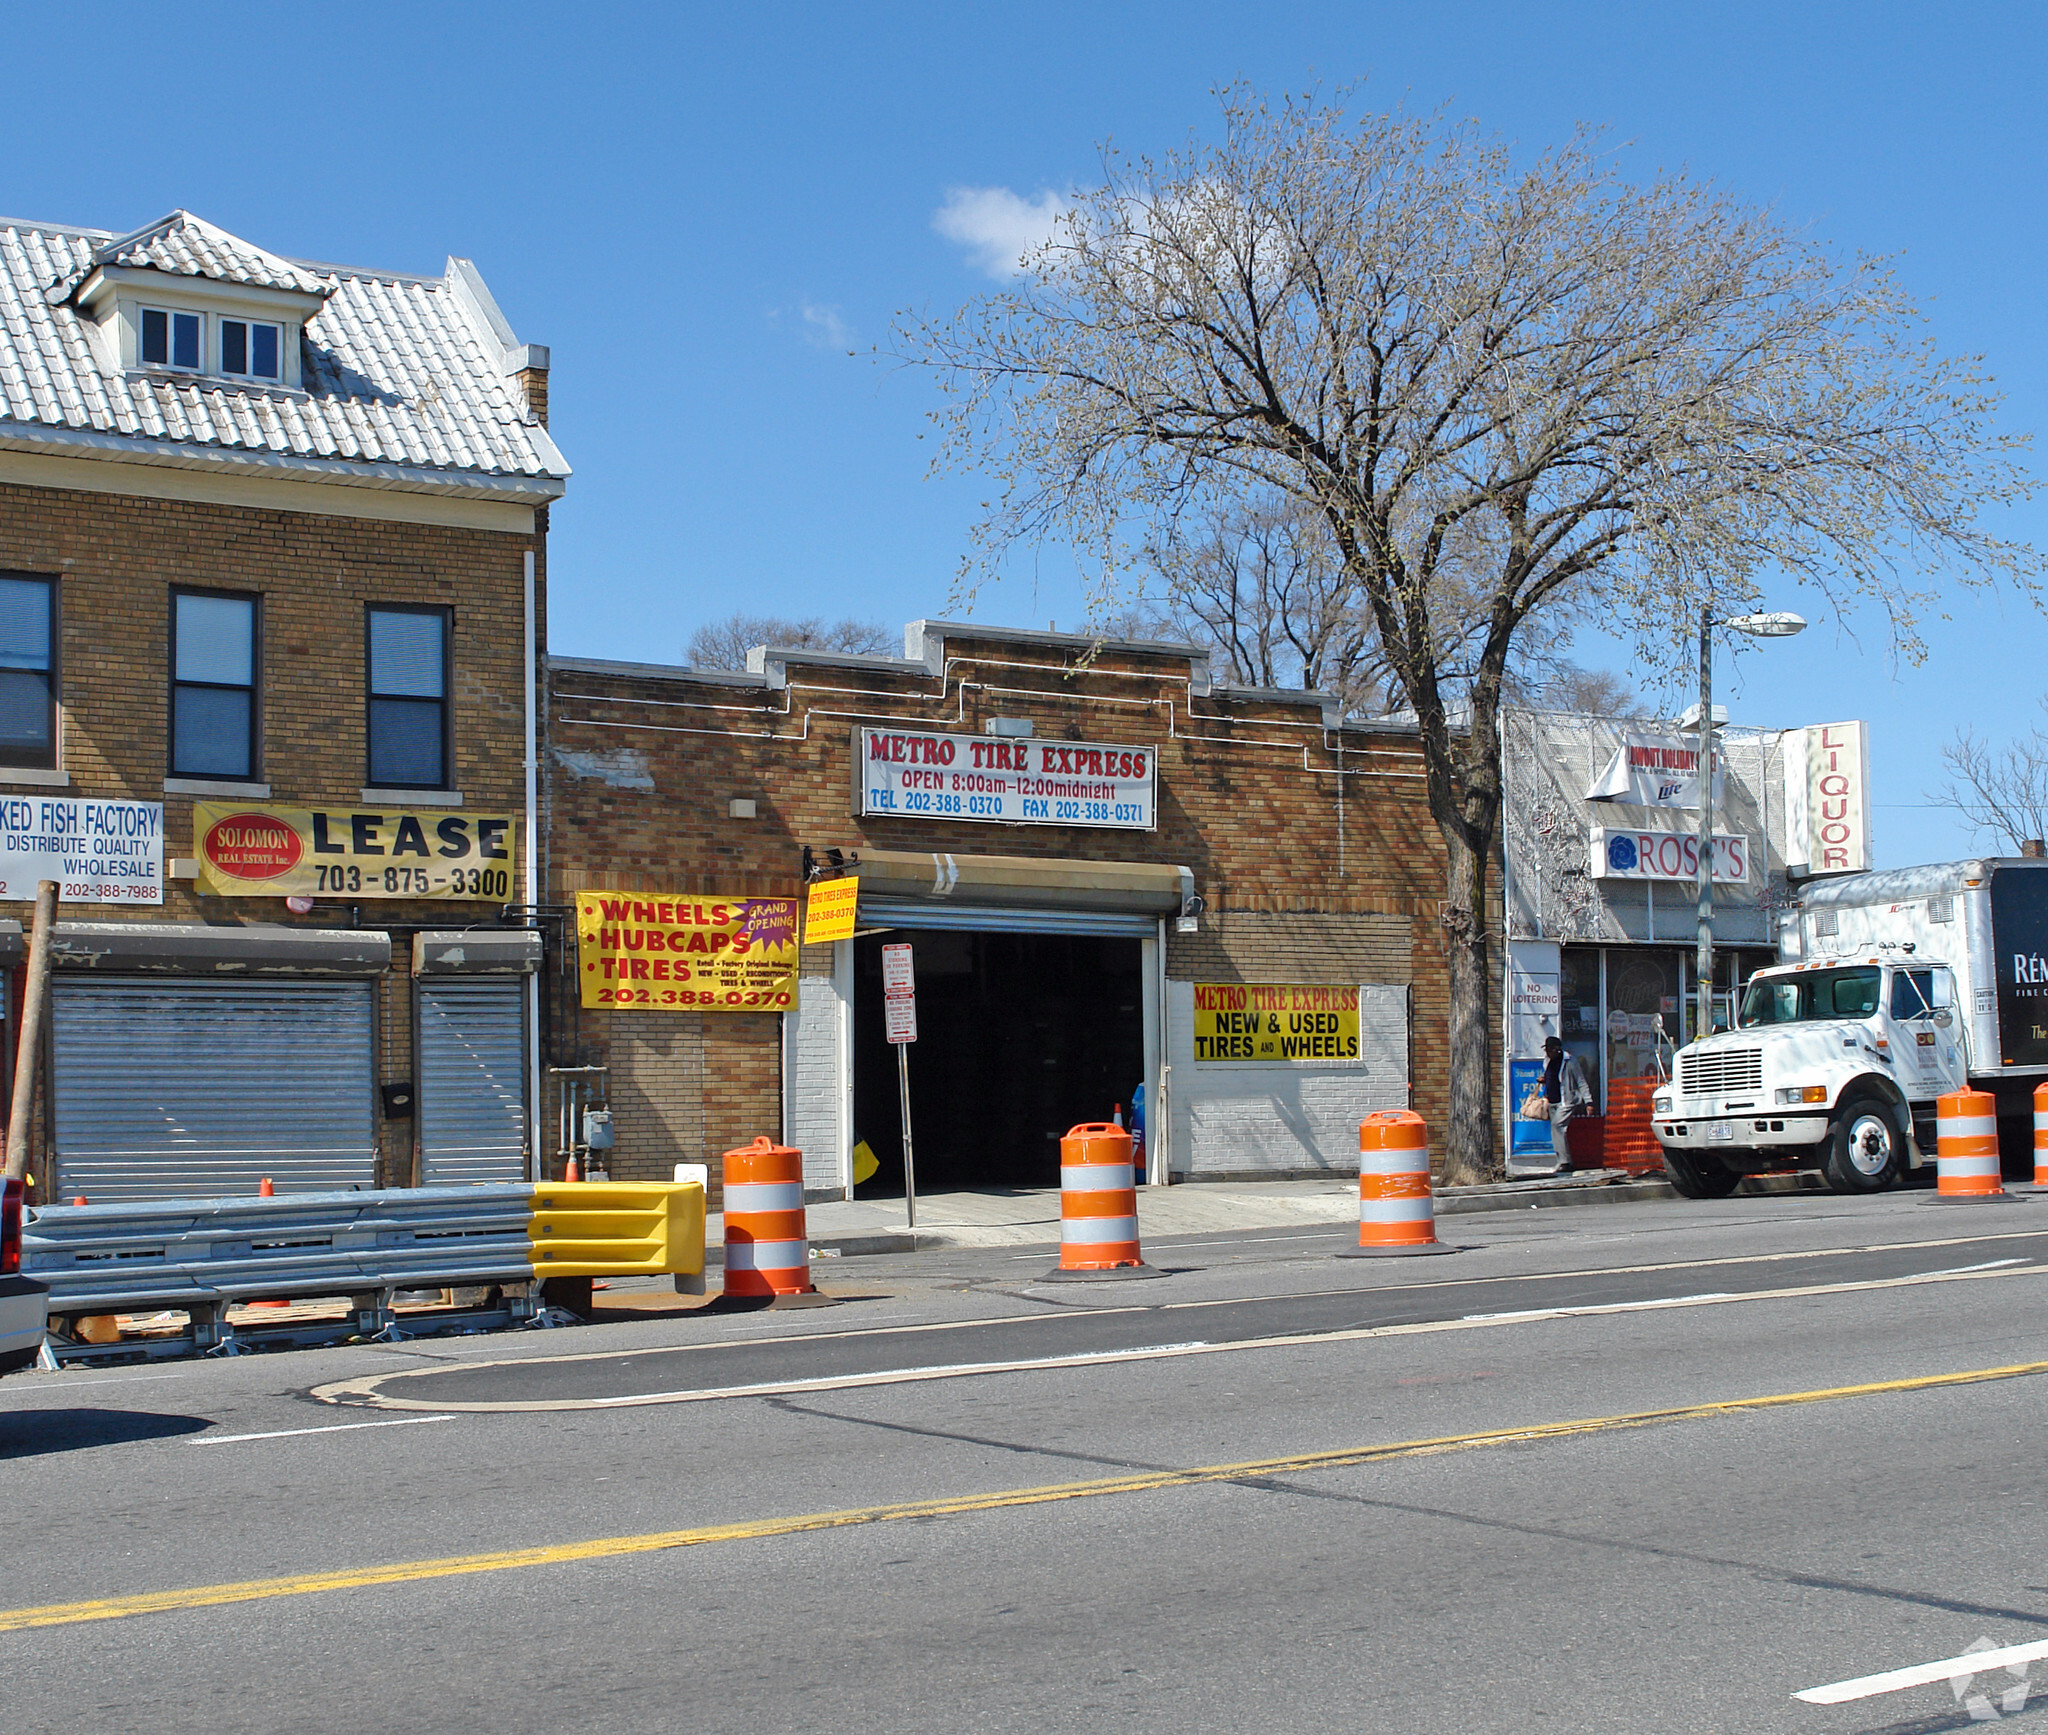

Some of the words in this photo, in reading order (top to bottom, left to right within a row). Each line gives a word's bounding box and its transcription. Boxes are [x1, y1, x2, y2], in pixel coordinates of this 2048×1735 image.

[870, 733, 956, 766] METRO
[970, 741, 1028, 771] TIRE
[1041, 746, 1146, 779] EXPRESS
[901, 769, 943, 790] OPEN
[870, 788, 898, 808] TEL
[905, 791, 1003, 815] 202-388-0370
[1657, 784, 1682, 800] Lite
[1820, 728, 1850, 868] LIQUOR
[41, 802, 77, 834] FISH
[85, 805, 157, 837] FACTORY
[1023, 799, 1049, 818] FAX
[1056, 801, 1143, 821] 202-388-0371
[7, 835, 86, 854] DISTRIBUTE
[93, 838, 150, 856] QUALITY
[217, 827, 289, 849] SOLOMON
[313, 812, 509, 859] LEASE
[64, 858, 155, 877] WHOLESALE
[217, 853, 240, 863] REAL
[243, 854, 273, 864] ESTATE
[65, 883, 158, 898] 202-388-7988
[315, 865, 508, 897] 703-875-3300
[599, 899, 731, 926] WHEELS
[748, 902, 788, 917] GRAND
[808, 906, 855, 923] 202-388-0370
[748, 915, 794, 931] OPENING
[600, 928, 751, 954] HUBCAPS
[600, 957, 691, 981] TIRES
[722, 960, 744, 968] Factory
[597, 988, 791, 1006] 202.388.0370
[1194, 986, 1247, 1011] METRO
[1251, 987, 1288, 1011] TIRE
[1291, 987, 1359, 1012] EXPRESS
[1527, 984, 1541, 993] NO
[2016, 989, 2039, 998] FINE
[1512, 995, 1558, 1004] LOITERING
[1216, 1013, 1259, 1034] NEW
[1267, 1013, 1281, 1034] &
[1289, 1013, 1339, 1034] USED
[2031, 1025, 2048, 1040] The
[1195, 1036, 1254, 1058] TIRES
[1260, 1042, 1274, 1053] AND
[1280, 1036, 1358, 1058] WHEELS
